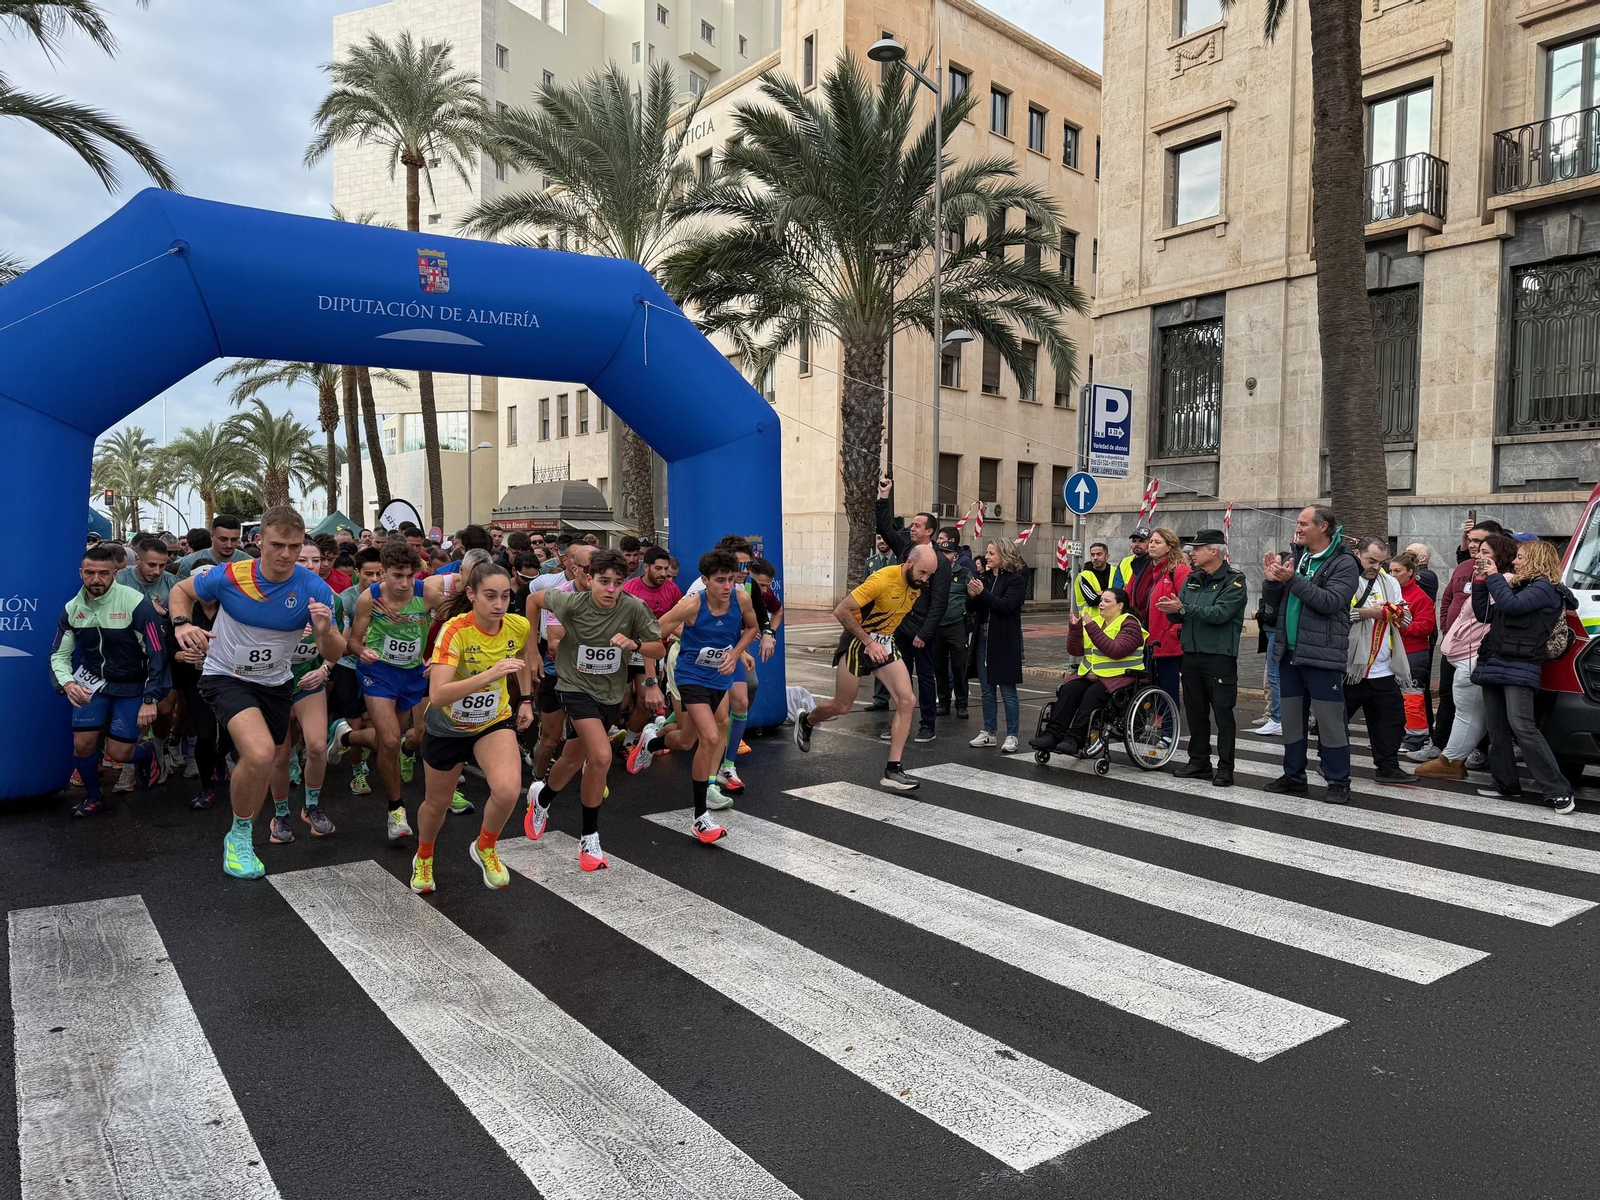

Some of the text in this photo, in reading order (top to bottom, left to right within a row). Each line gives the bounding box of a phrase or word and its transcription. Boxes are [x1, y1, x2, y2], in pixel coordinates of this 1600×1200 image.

[317, 295, 540, 328] DIPUTACIÓN DE ALMERÍA
[1094, 386, 1129, 438] P
[389, 640, 416, 653] 865
[249, 649, 272, 663] 83
[585, 648, 615, 661] 966
[462, 694, 495, 709] 686
